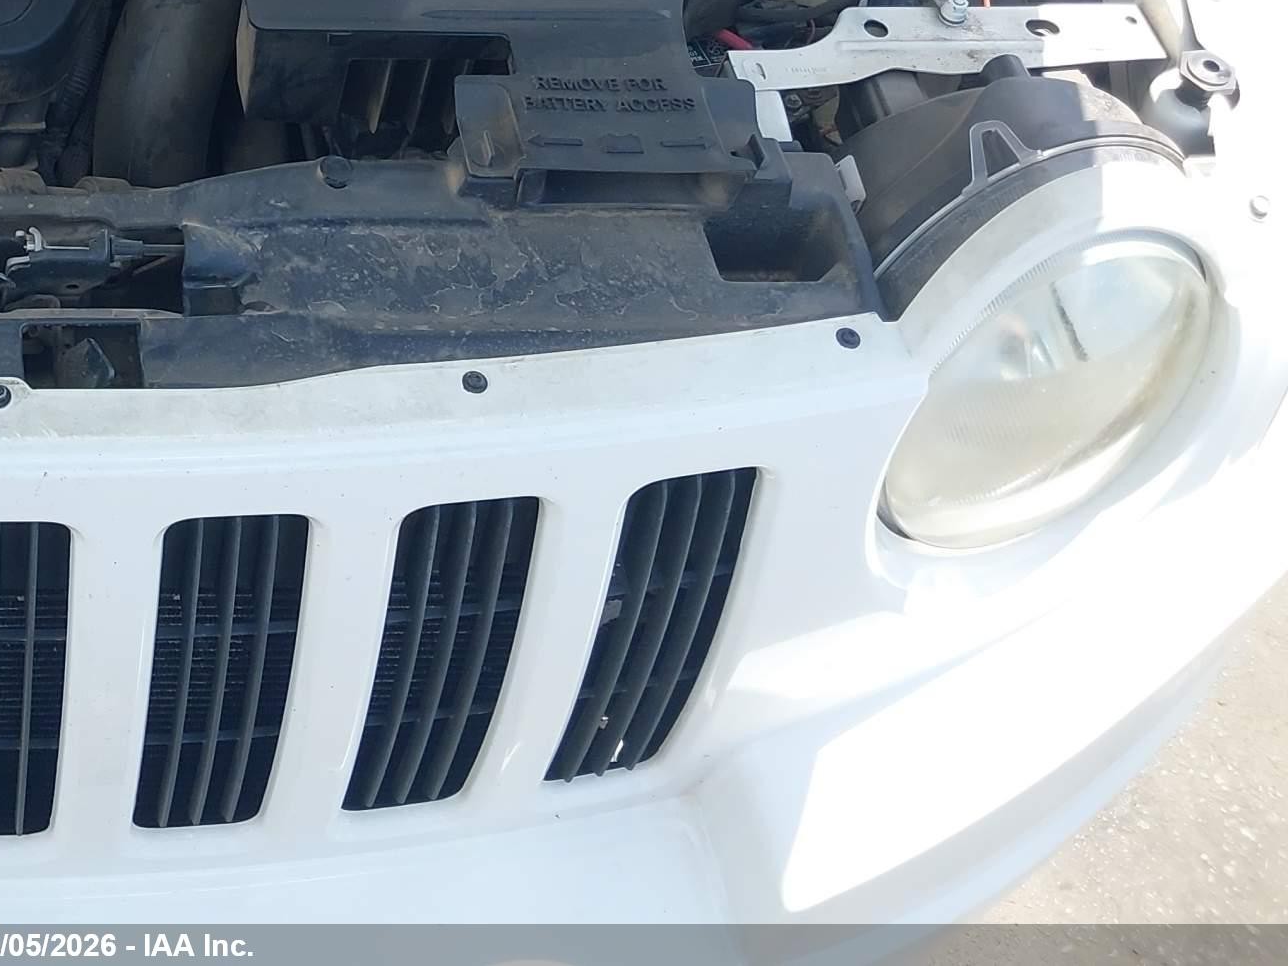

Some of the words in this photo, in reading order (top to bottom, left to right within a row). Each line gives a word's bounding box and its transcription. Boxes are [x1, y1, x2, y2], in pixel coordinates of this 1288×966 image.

[535, 76, 621, 92] REMOVE
[626, 77, 669, 93] FOR
[523, 96, 608, 113] BATTERY
[616, 97, 697, 114] ACCESS
